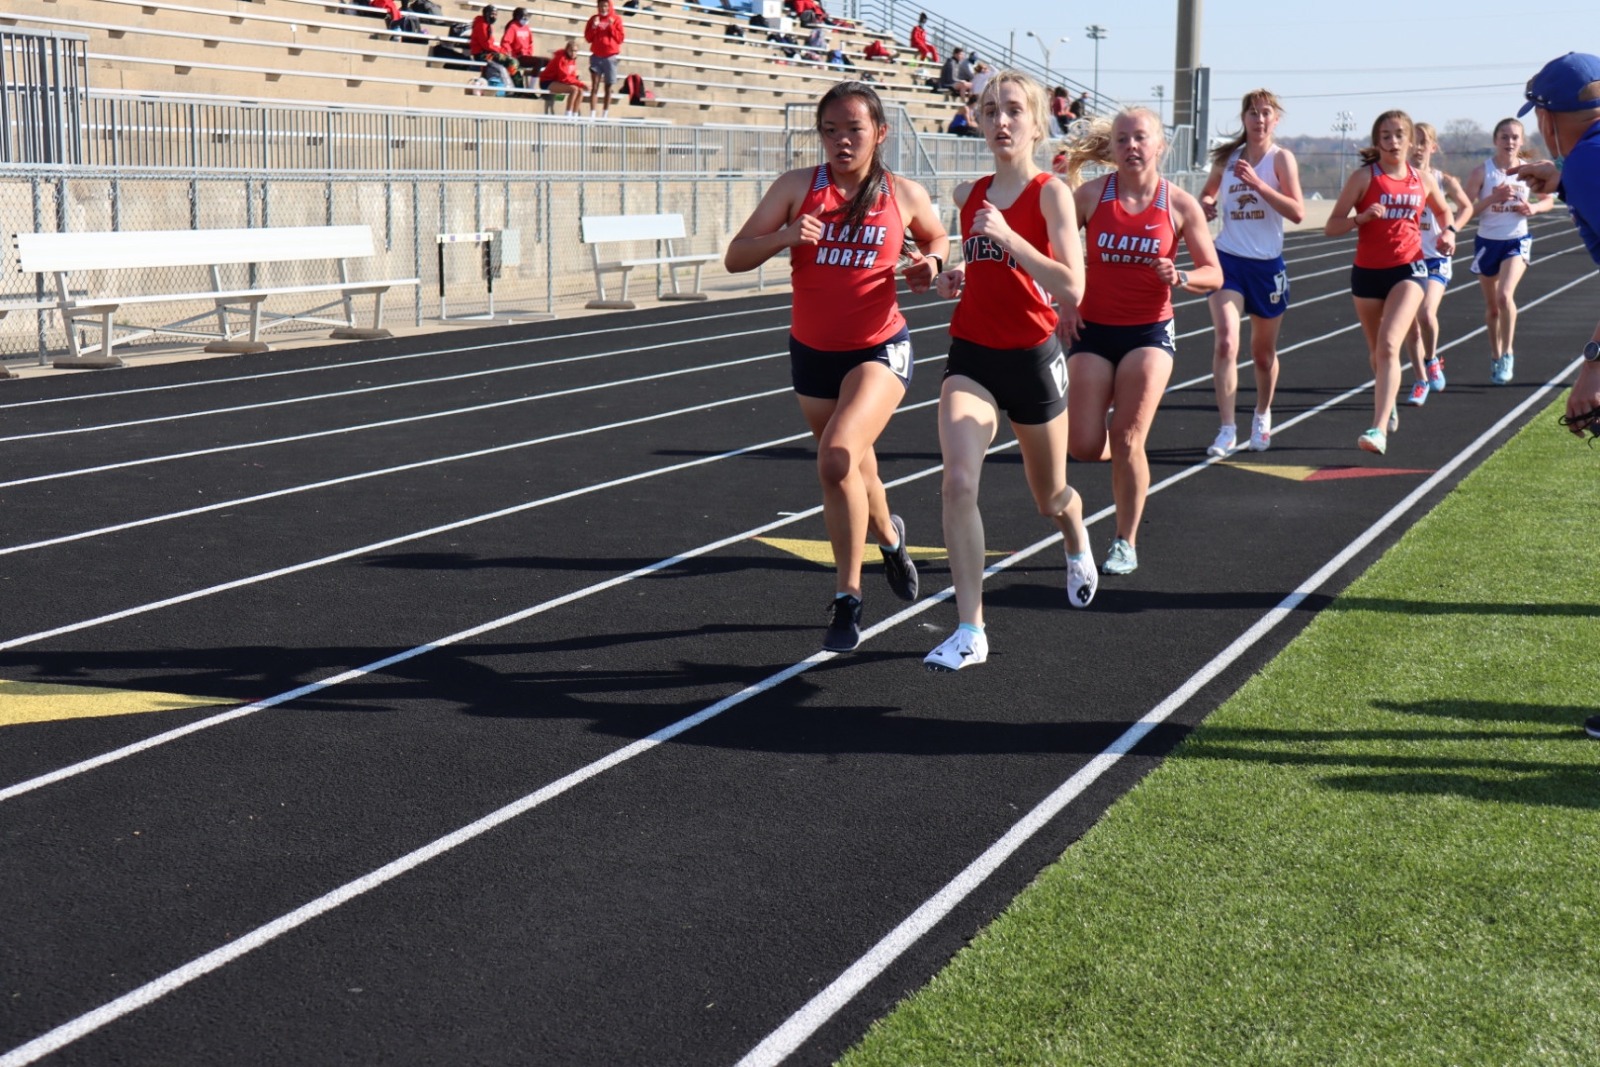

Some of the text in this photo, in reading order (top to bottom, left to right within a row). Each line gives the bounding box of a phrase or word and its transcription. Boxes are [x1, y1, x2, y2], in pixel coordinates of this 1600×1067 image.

[1380, 193, 1422, 207] OLATHE
[819, 221, 888, 246] OLATHE
[1097, 232, 1161, 255] OLATHE
[815, 246, 879, 270] NORTH
[1277, 274, 1285, 292] 7
[1055, 357, 1068, 391] 2
